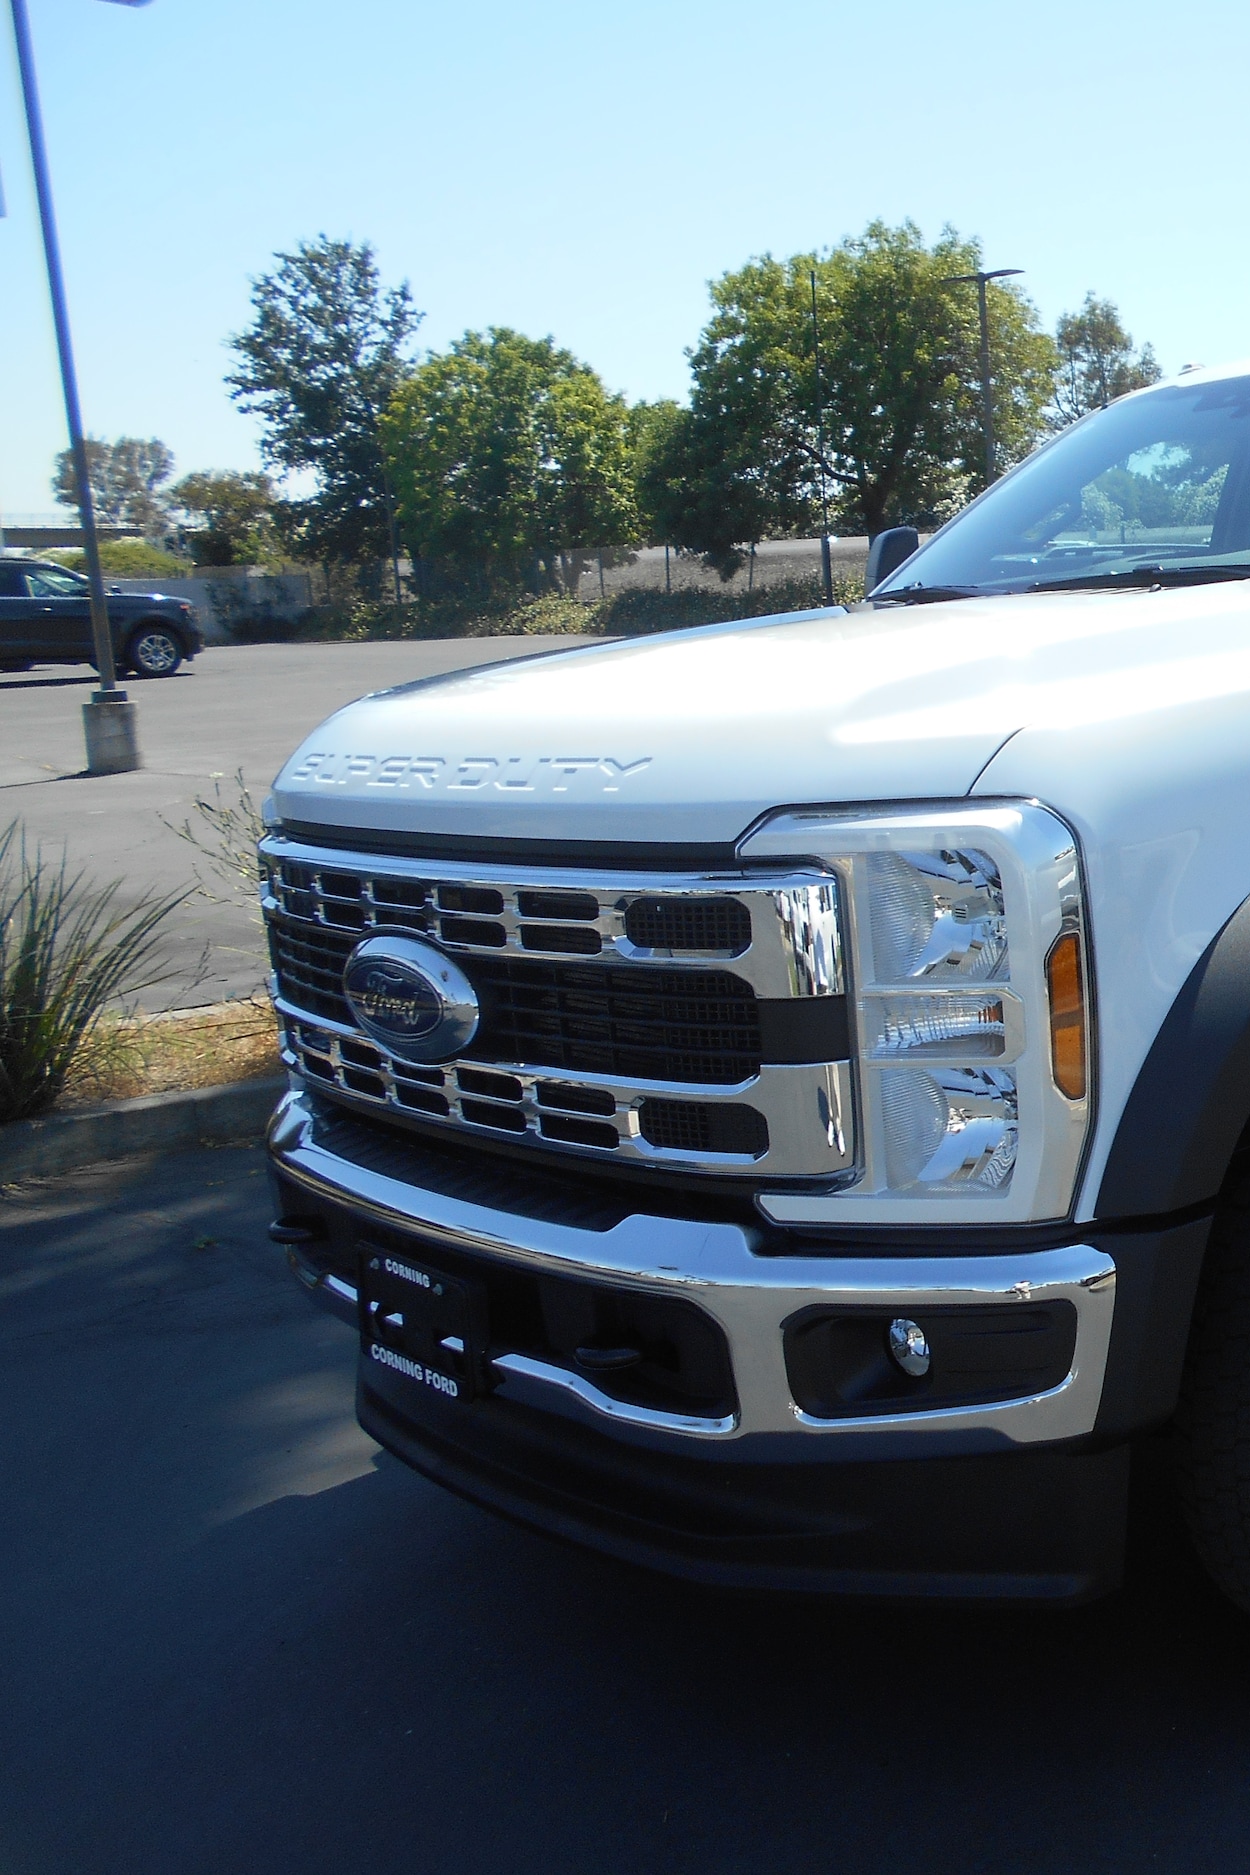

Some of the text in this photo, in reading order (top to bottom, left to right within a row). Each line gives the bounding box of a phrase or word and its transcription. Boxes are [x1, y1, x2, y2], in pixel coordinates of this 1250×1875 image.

[291, 752, 653, 792] SUPER DUTY
[384, 1258, 430, 1288] CORNING
[370, 1343, 458, 1397] CORNING FORD
